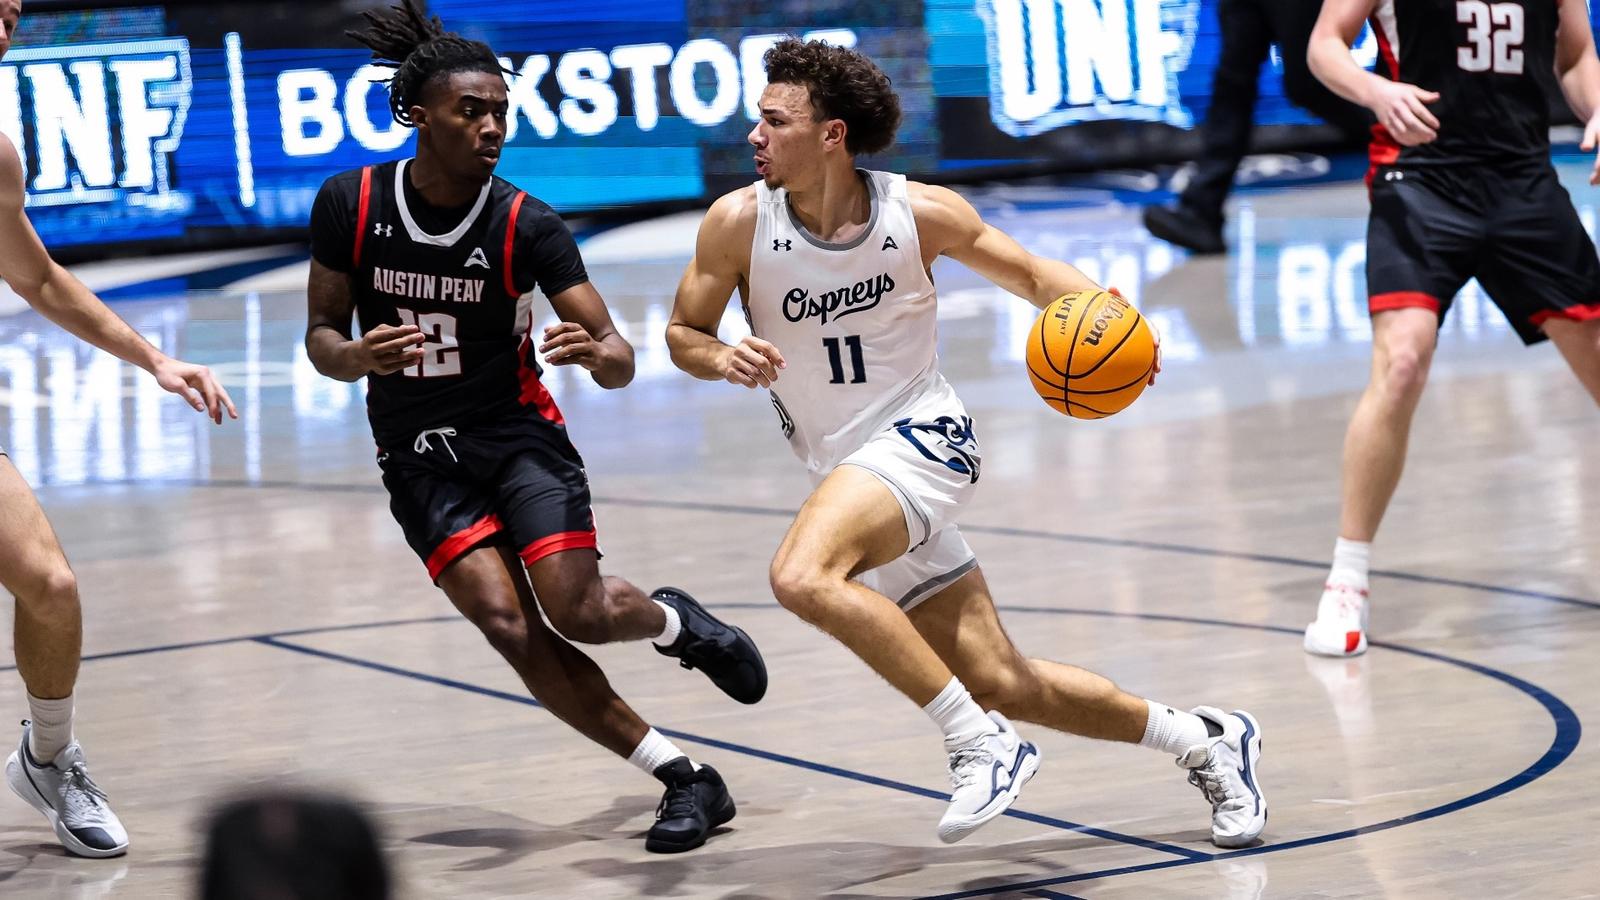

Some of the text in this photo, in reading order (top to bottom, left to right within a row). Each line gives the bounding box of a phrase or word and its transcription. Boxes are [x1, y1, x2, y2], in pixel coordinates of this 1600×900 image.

[1456, 0, 1524, 75] 32
[373, 266, 485, 302] AUSTIN PEAY
[782, 272, 895, 326] Ospreys
[822, 334, 867, 384] 11
